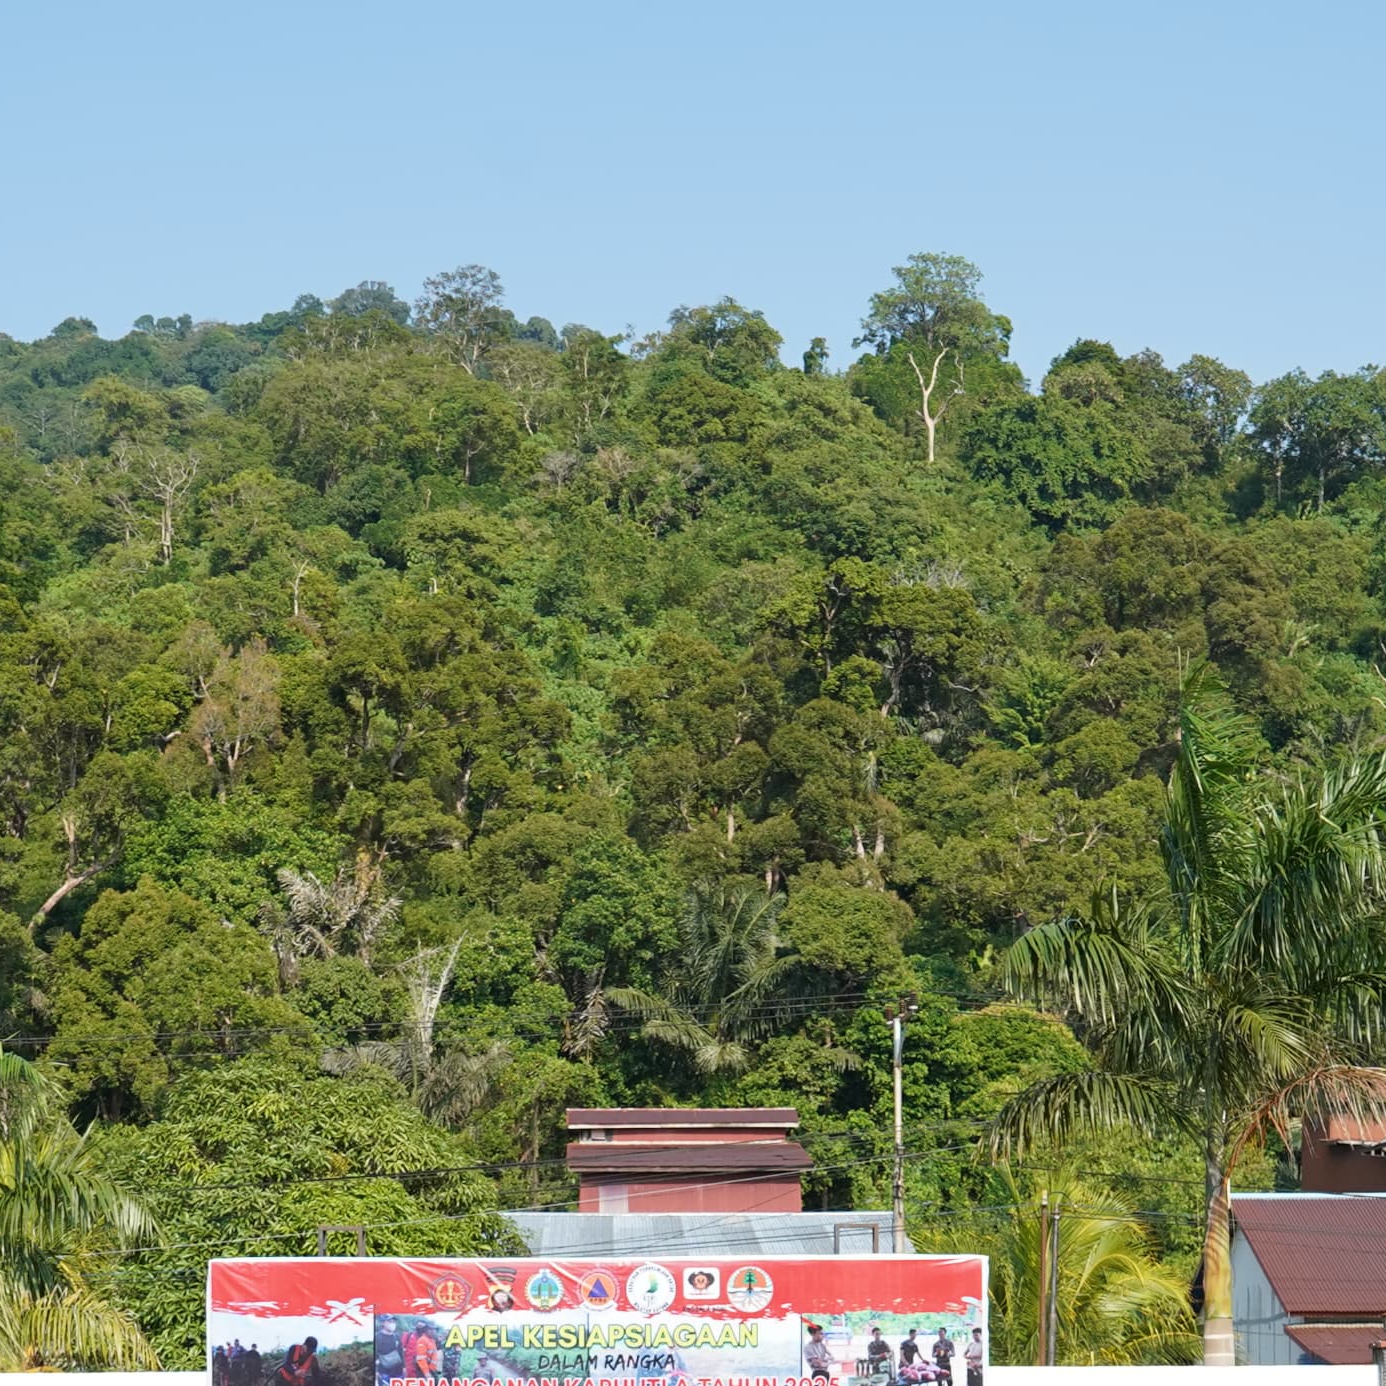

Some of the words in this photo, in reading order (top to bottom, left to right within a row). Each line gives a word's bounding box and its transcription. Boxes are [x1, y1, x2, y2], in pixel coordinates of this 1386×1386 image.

[444, 1324, 515, 1349] APEL
[522, 1323, 759, 1349] KESIAPSIAGAAN
[538, 1353, 598, 1371] DALAM
[604, 1352, 676, 1370] RANGKA
